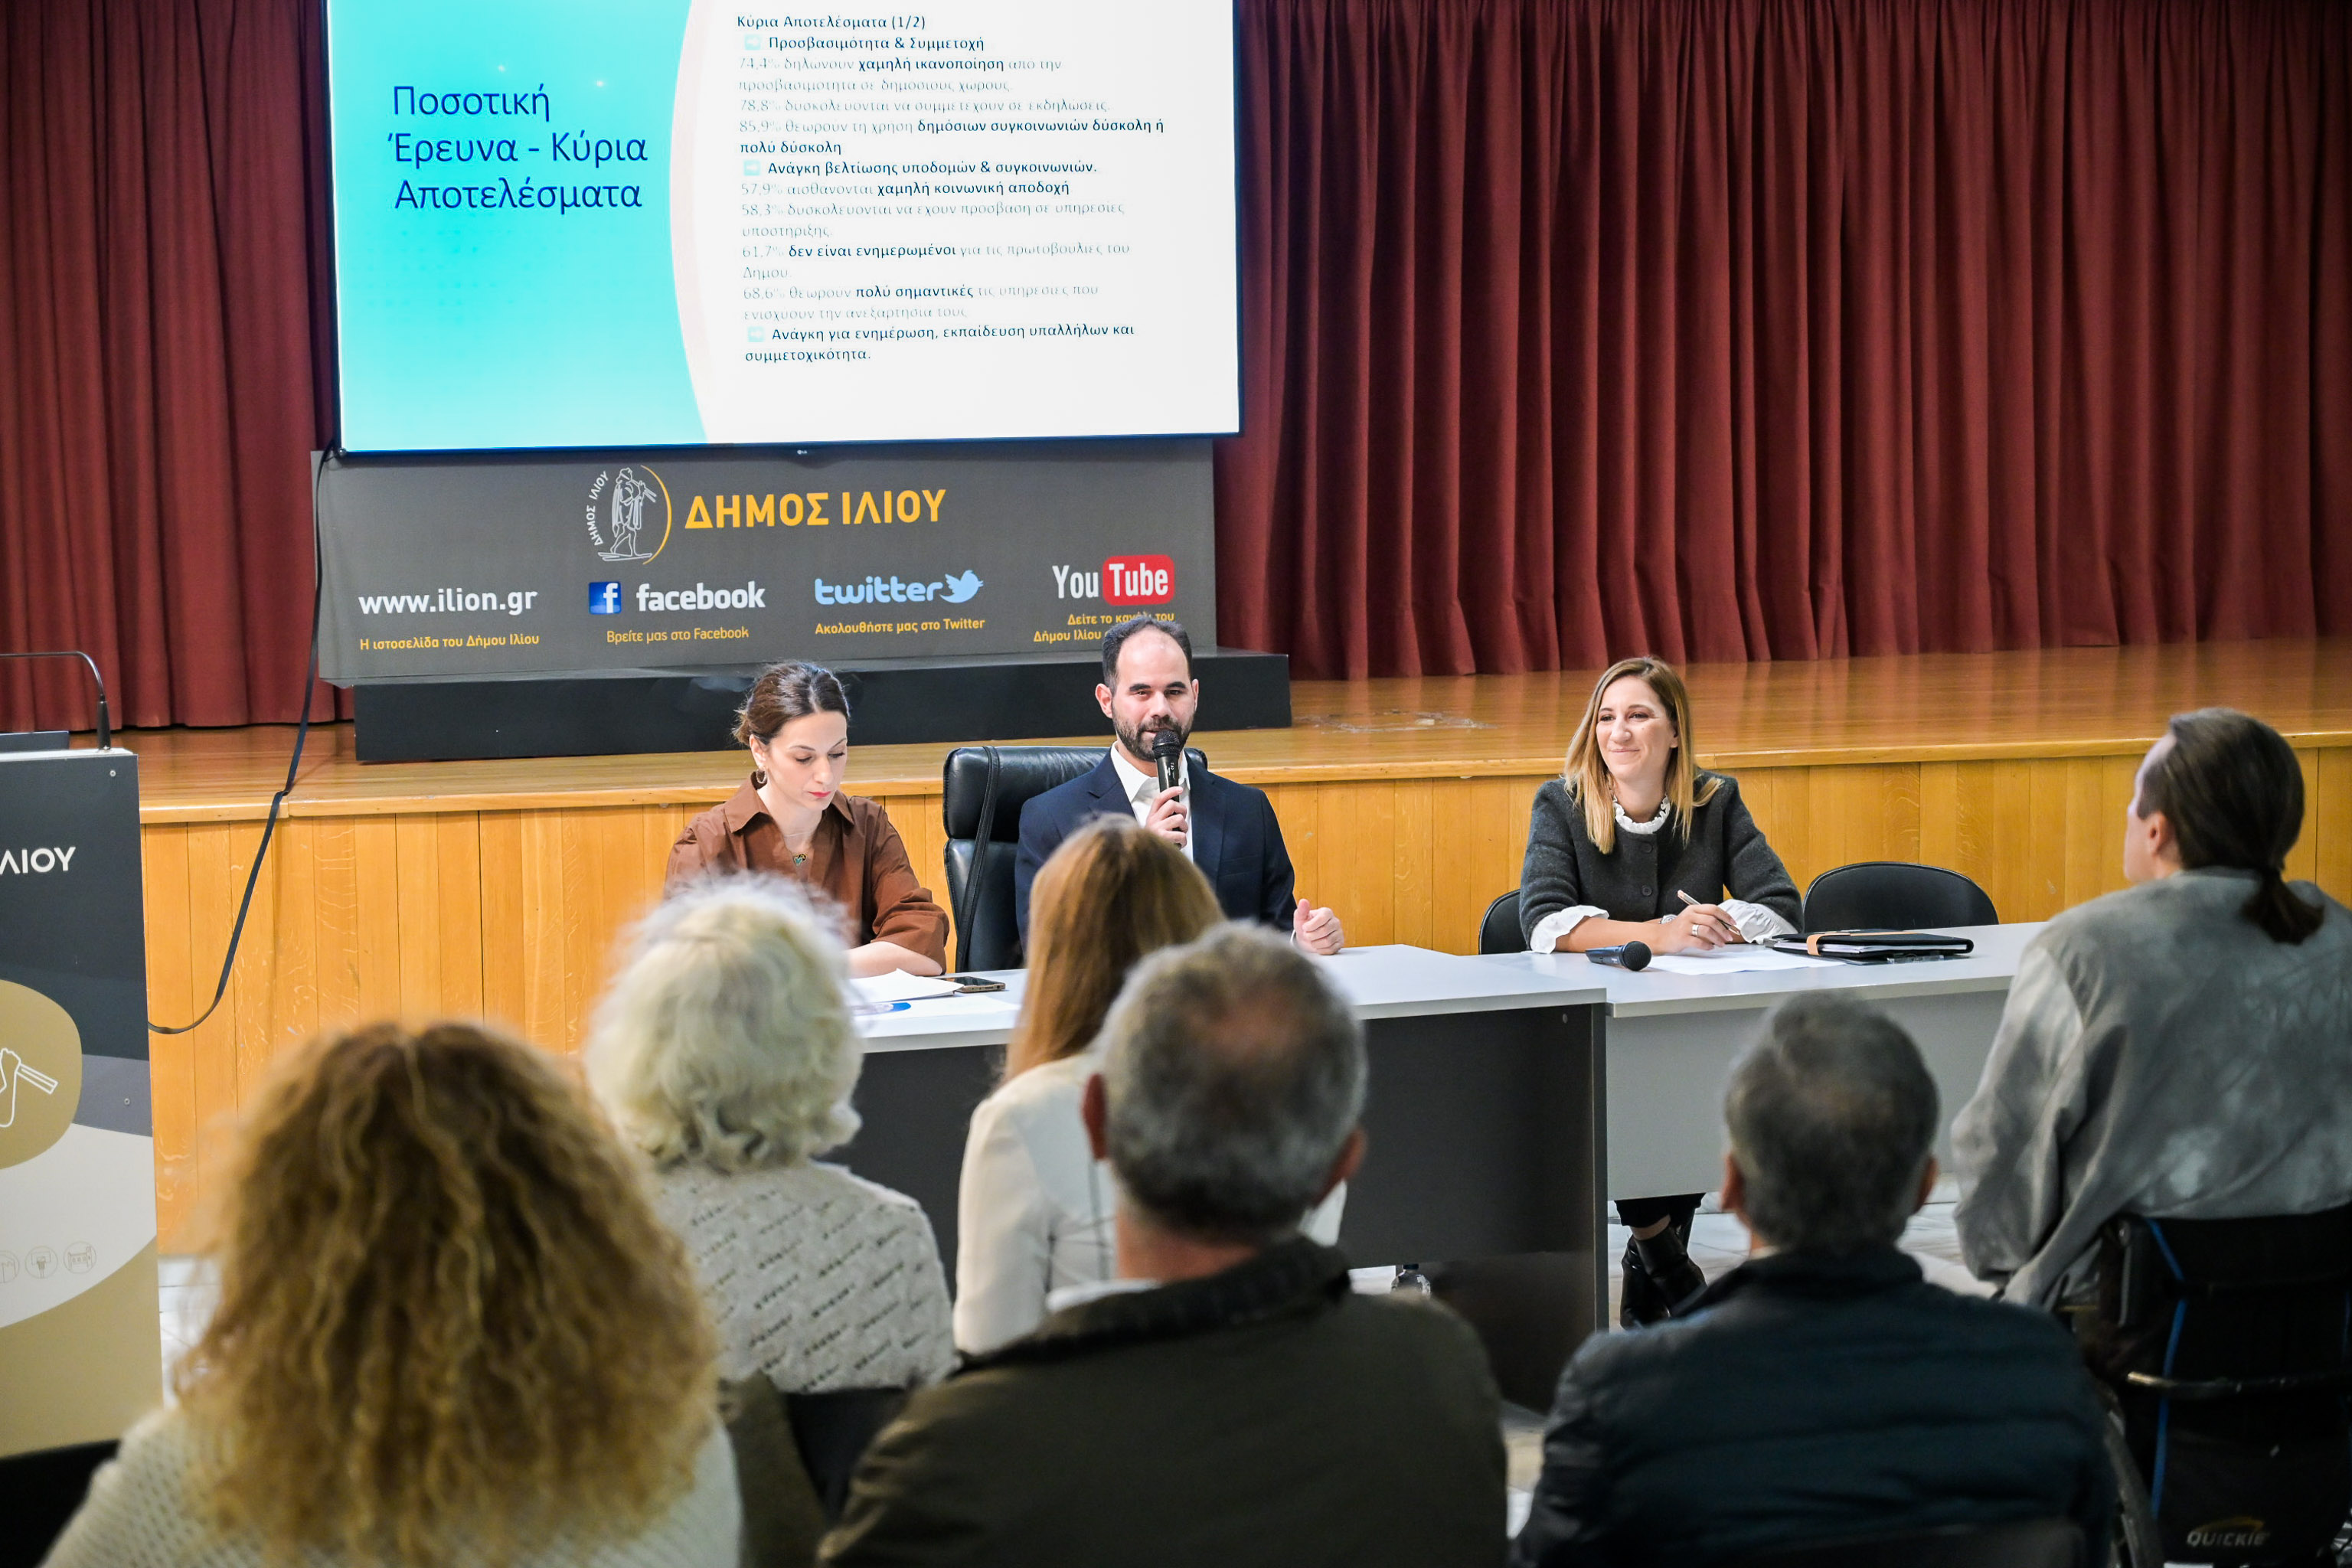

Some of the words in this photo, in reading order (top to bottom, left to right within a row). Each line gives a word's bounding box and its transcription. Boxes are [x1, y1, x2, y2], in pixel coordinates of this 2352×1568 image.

[737, 15, 779, 30] Κύρια
[784, 15, 887, 30] Αποτελέσματα
[892, 15, 926, 30] (1/2)
[769, 37, 890, 51] Προσβασιμότητα
[894, 38, 906, 48] &
[910, 37, 985, 51] Συμμετοχή
[858, 57, 911, 72] χαμηλή
[916, 57, 1004, 71] ικανοποίηση
[1040, 60, 1062, 72] την
[394, 83, 550, 122] Ποσοτική
[894, 103, 911, 111] να
[853, 123, 867, 134] τη
[917, 119, 986, 133] δημόσιων
[991, 119, 1089, 133] συγκοινωνιών
[1093, 119, 1152, 132] δύσκολη
[1156, 119, 1165, 132] ή
[388, 132, 518, 169] Έρευνα
[552, 130, 648, 168] Κύρια
[740, 141, 776, 153] πολύ
[780, 141, 842, 155] δύσκολη
[768, 162, 821, 176] Ανάγκη
[825, 162, 899, 176] βελτίωσης
[903, 161, 977, 175] υποδομών
[980, 161, 991, 172] &
[995, 160, 1098, 175] συγκοινωνιών.
[395, 177, 642, 214] Αποτελέσματα
[877, 181, 930, 196] χαμηλή
[935, 181, 1004, 195] κοινωνική
[1008, 181, 1070, 195] αποδοχή
[897, 206, 913, 214] να
[1036, 205, 1050, 214] σε
[789, 245, 813, 256] δεν
[818, 245, 852, 256] είναι
[856, 243, 957, 259] ενημερωμένοι
[960, 247, 981, 258] για
[986, 246, 1003, 257] τις
[1107, 245, 1130, 253] του
[856, 285, 891, 297] πολύ
[896, 284, 974, 299] σημαντικές
[978, 288, 995, 297] τις
[1073, 286, 1099, 294] που
[820, 310, 841, 321] την
[772, 328, 825, 342] Ανάγκη
[829, 331, 851, 341] για
[855, 326, 939, 341] ενημέρωση,
[943, 325, 1025, 338] εκπαίδευση
[1030, 323, 1109, 338] υπαλλήλων
[1113, 326, 1135, 335] και
[746, 348, 871, 364] συμμετοχικότητα.
[589, 471, 609, 500] ΙΛΙΟΥ
[684, 492, 829, 529] ΔΗΜΟΣ
[842, 489, 946, 524] ΙΛΙΟΥ
[586, 505, 604, 546] ΔΗΜΟΣ
[636, 581, 766, 612] facebook
[815, 576, 943, 606] twitter
[358, 588, 538, 616] www.ilion.gr
[1067, 614, 1098, 626] Δείτε
[1101, 616, 1112, 624] το
[1155, 612, 1174, 622] του
[606, 629, 643, 645] Βρείτε
[646, 631, 668, 644] μας
[671, 629, 691, 641] στο
[694, 626, 749, 640] Facebook
[815, 622, 893, 636] Ακολουθήστε
[897, 622, 918, 635] μας
[921, 622, 940, 632] στο
[943, 619, 985, 630] Twitter
[360, 639, 369, 651] Η
[373, 636, 439, 651] ιστοσελίδα
[443, 636, 463, 648] του
[466, 634, 506, 648] Δήμου
[510, 633, 539, 645] Ιλίου
[1034, 630, 1070, 644] Δήμου
[1073, 629, 1102, 641] Ιλίου
[2187, 1530, 2269, 1547] QUICKIE
